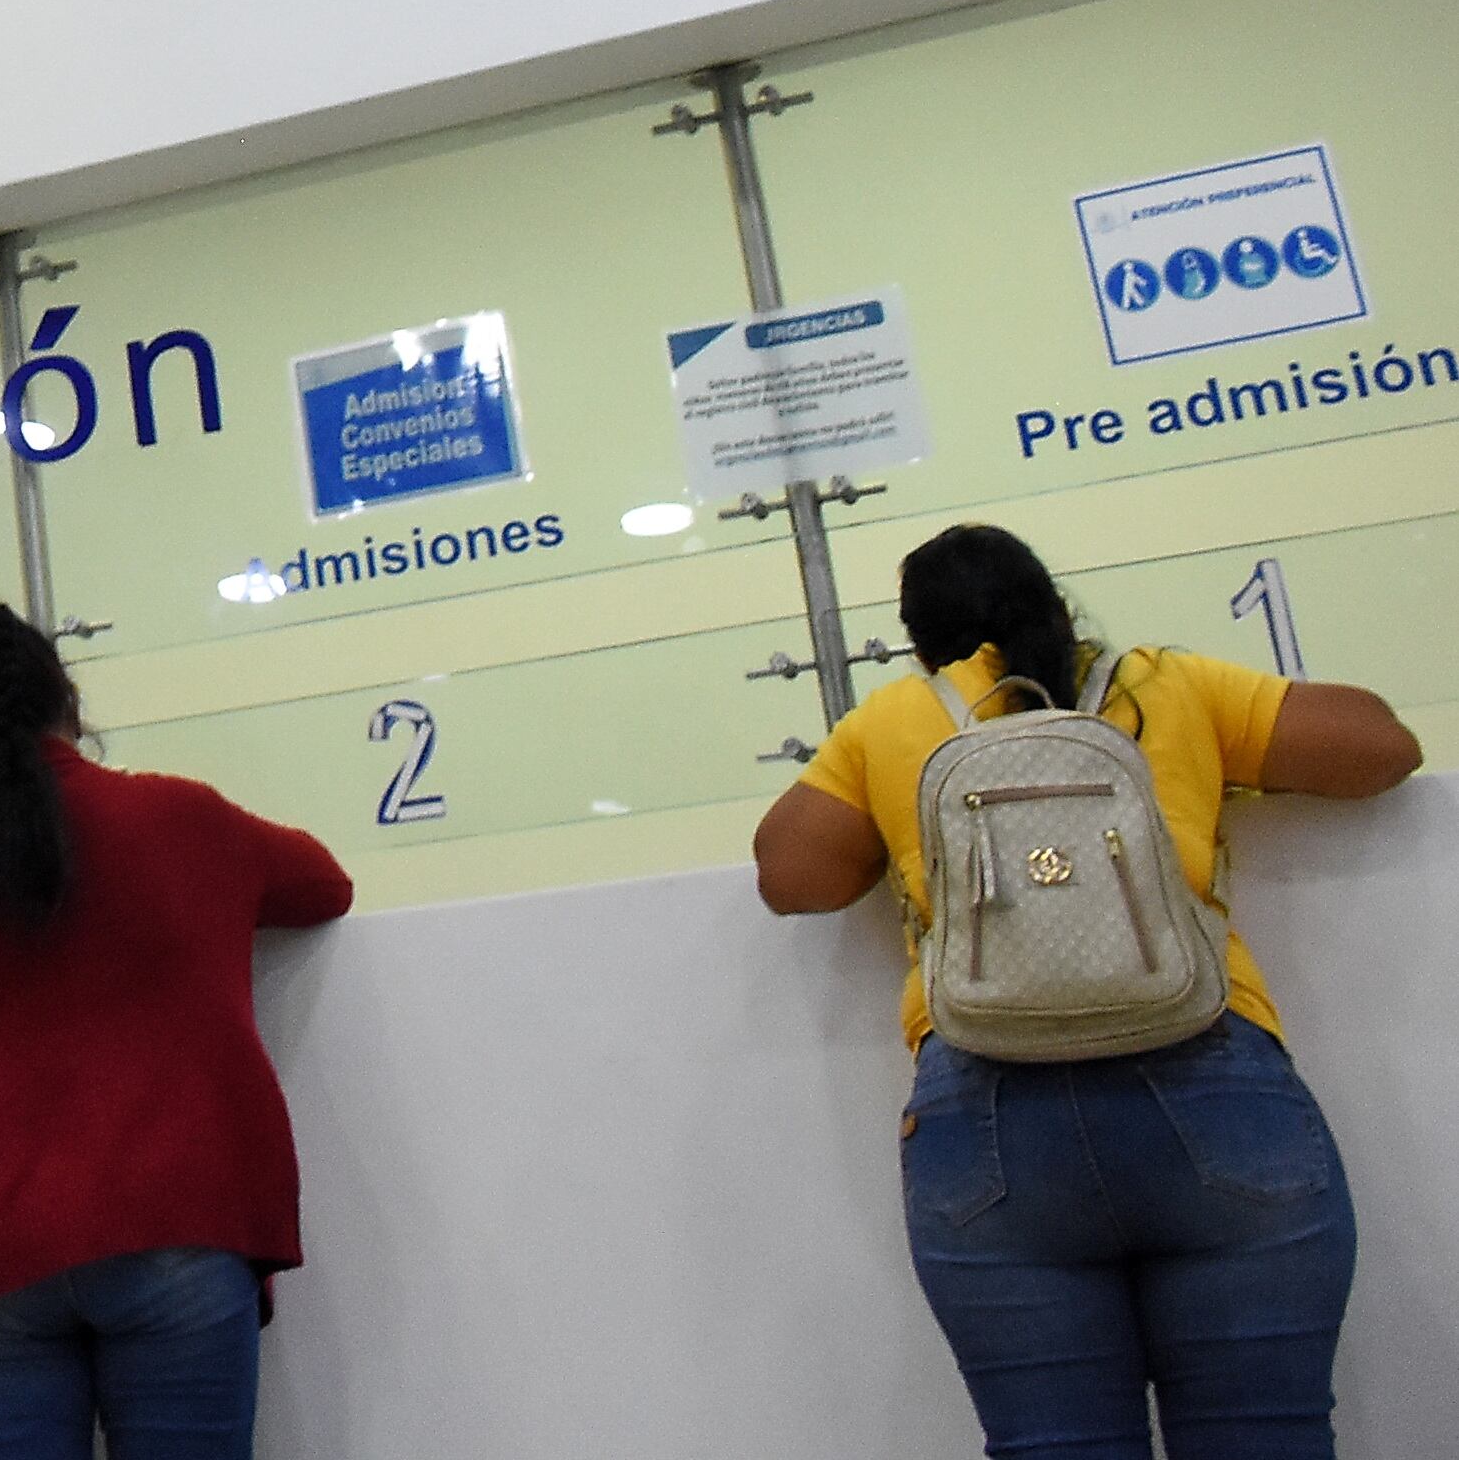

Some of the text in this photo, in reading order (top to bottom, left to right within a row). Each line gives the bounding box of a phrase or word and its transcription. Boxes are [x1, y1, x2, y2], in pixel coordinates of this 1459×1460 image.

[341, 404, 476, 450] Convenios
[1016, 343, 1459, 458] Pre admisión
[340, 435, 485, 482] Especiales
[1230, 558, 1307, 682] 1
[367, 700, 446, 824] 2
